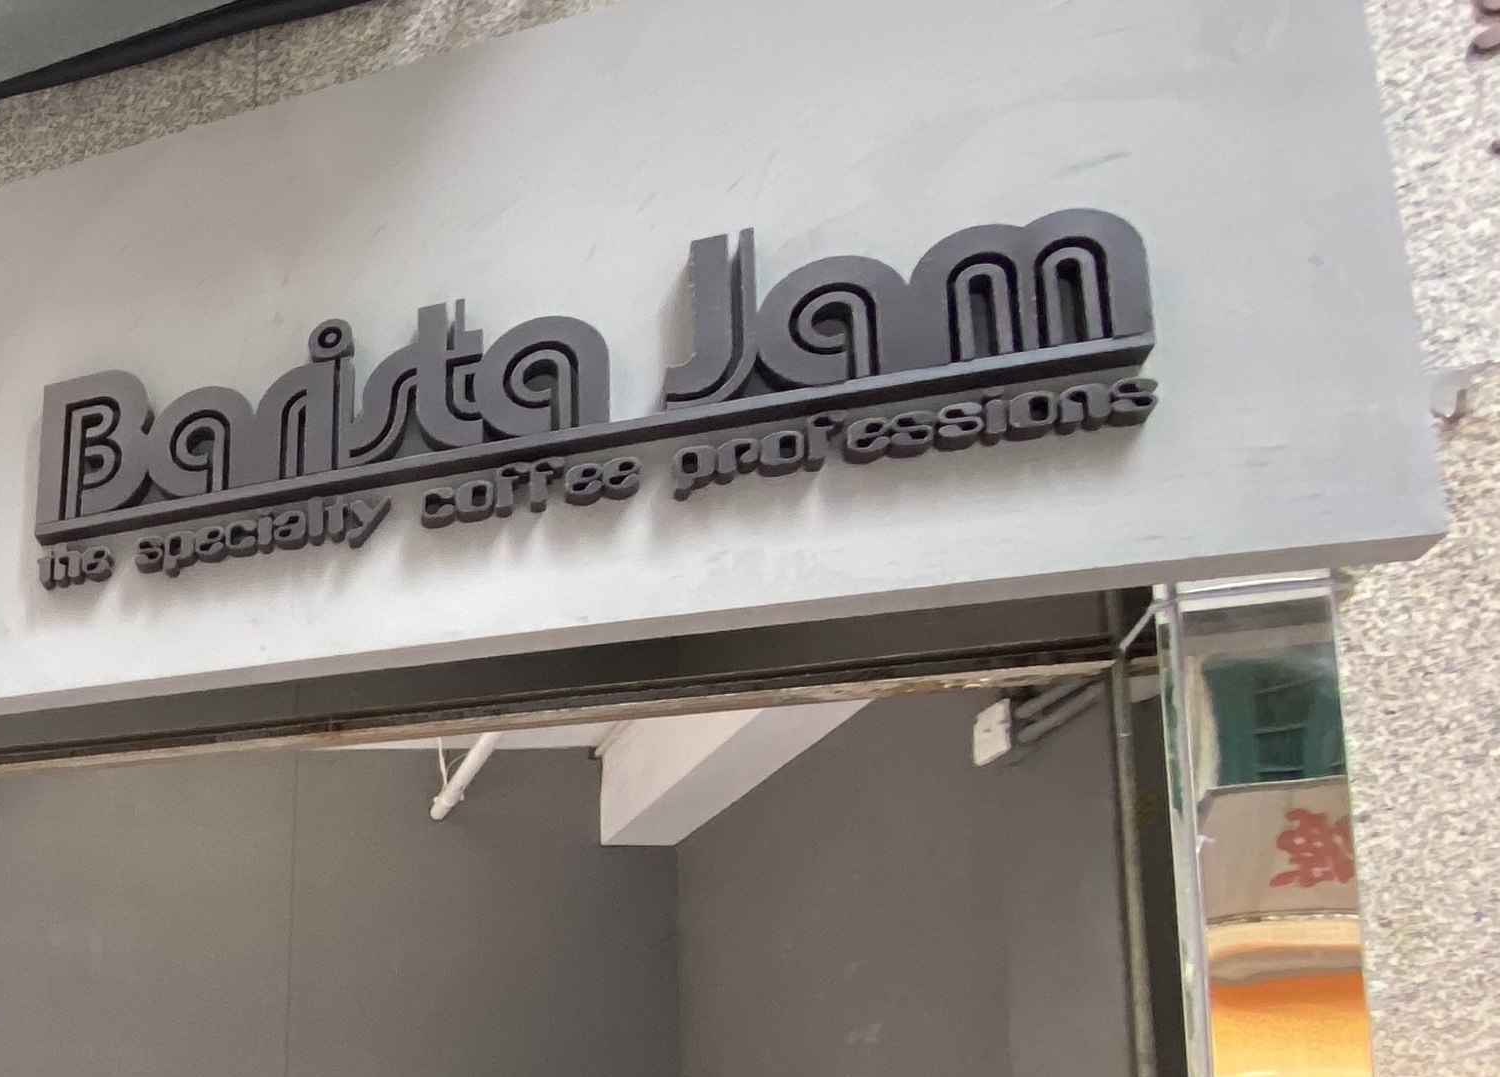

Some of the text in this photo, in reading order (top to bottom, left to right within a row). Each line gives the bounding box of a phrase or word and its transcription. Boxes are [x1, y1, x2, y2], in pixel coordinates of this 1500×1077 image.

[37, 377, 1158, 590] the specialty coffee professions
[40, 207, 1152, 523] Barista Jam
